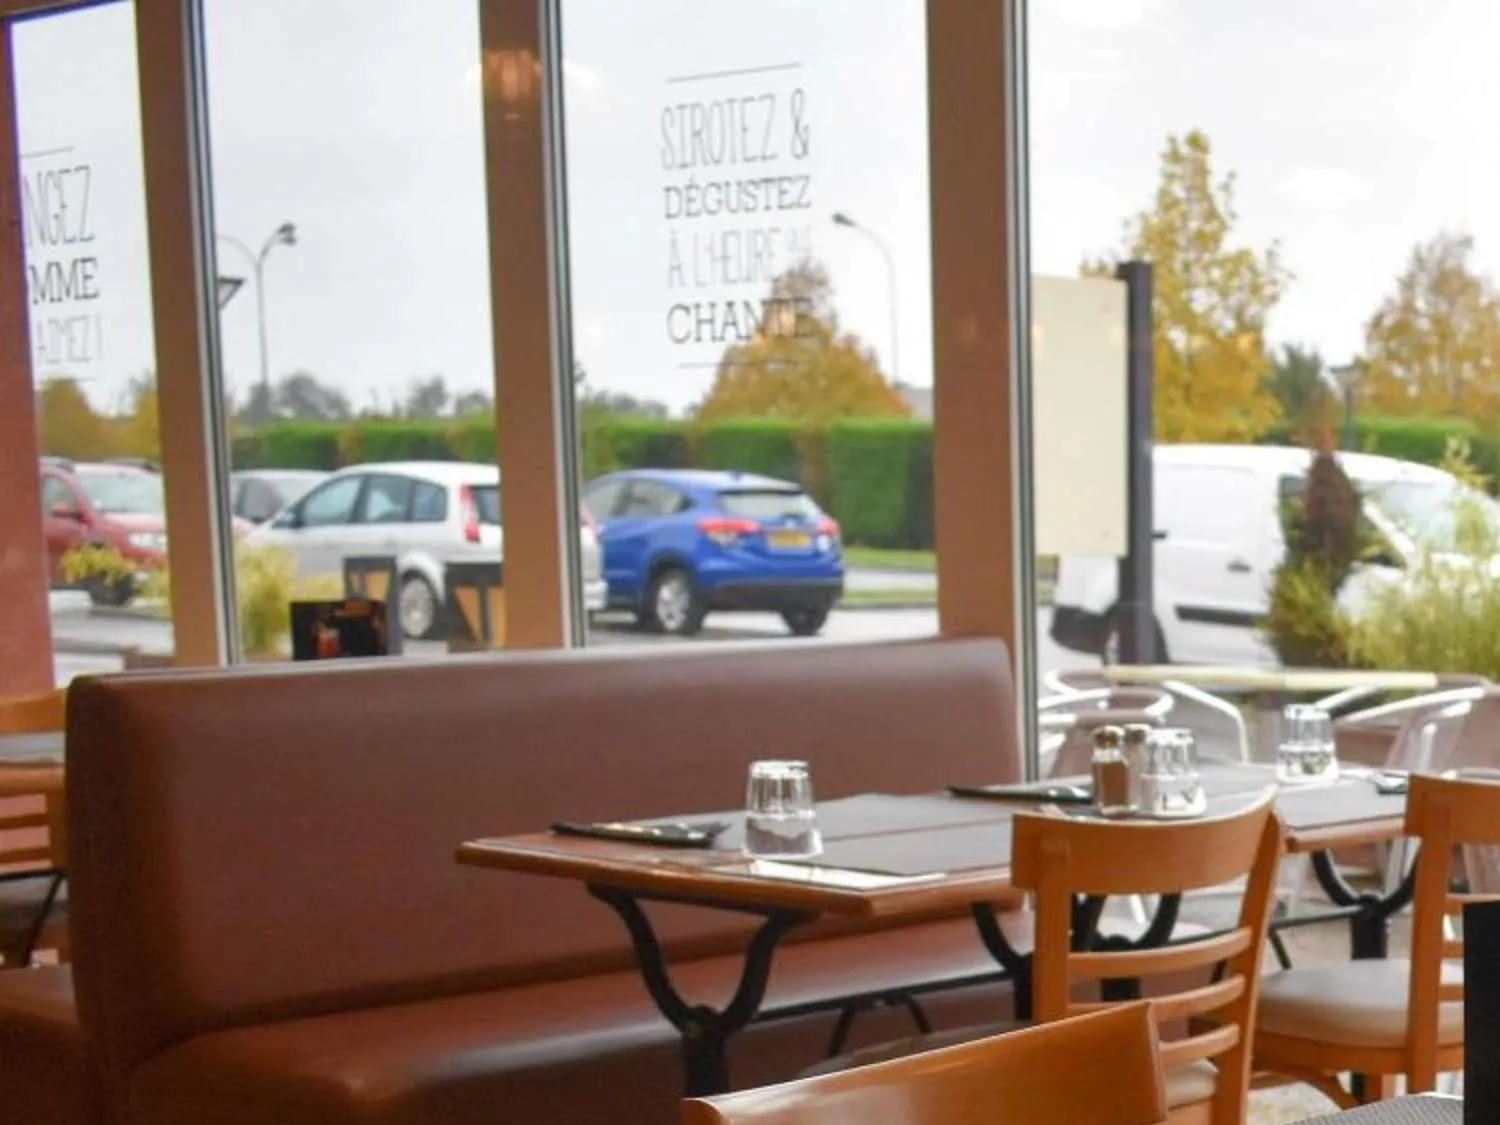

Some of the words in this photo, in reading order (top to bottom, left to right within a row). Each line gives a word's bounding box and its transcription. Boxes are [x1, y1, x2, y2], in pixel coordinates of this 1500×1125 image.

[661, 94, 777, 170] SIROTEZ
[789, 87, 810, 160] &
[663, 174, 812, 220] DÉGUSTEZ
